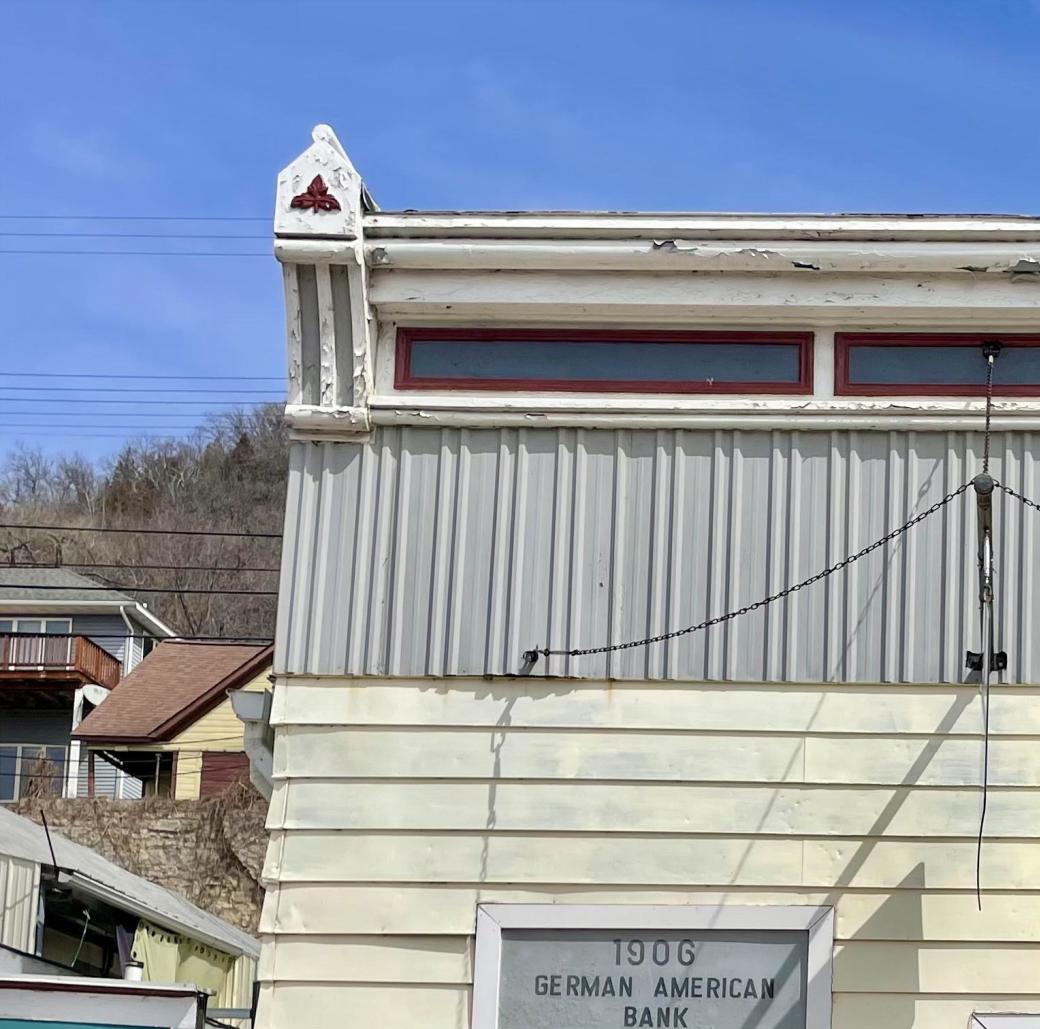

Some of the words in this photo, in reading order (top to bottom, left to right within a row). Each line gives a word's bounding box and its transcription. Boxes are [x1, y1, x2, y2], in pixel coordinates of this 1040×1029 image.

[612, 938, 697, 967] 1906
[534, 975, 634, 998] GERMAN
[653, 976, 775, 1000] AMERICAN
[623, 1006, 689, 1029] BANK
